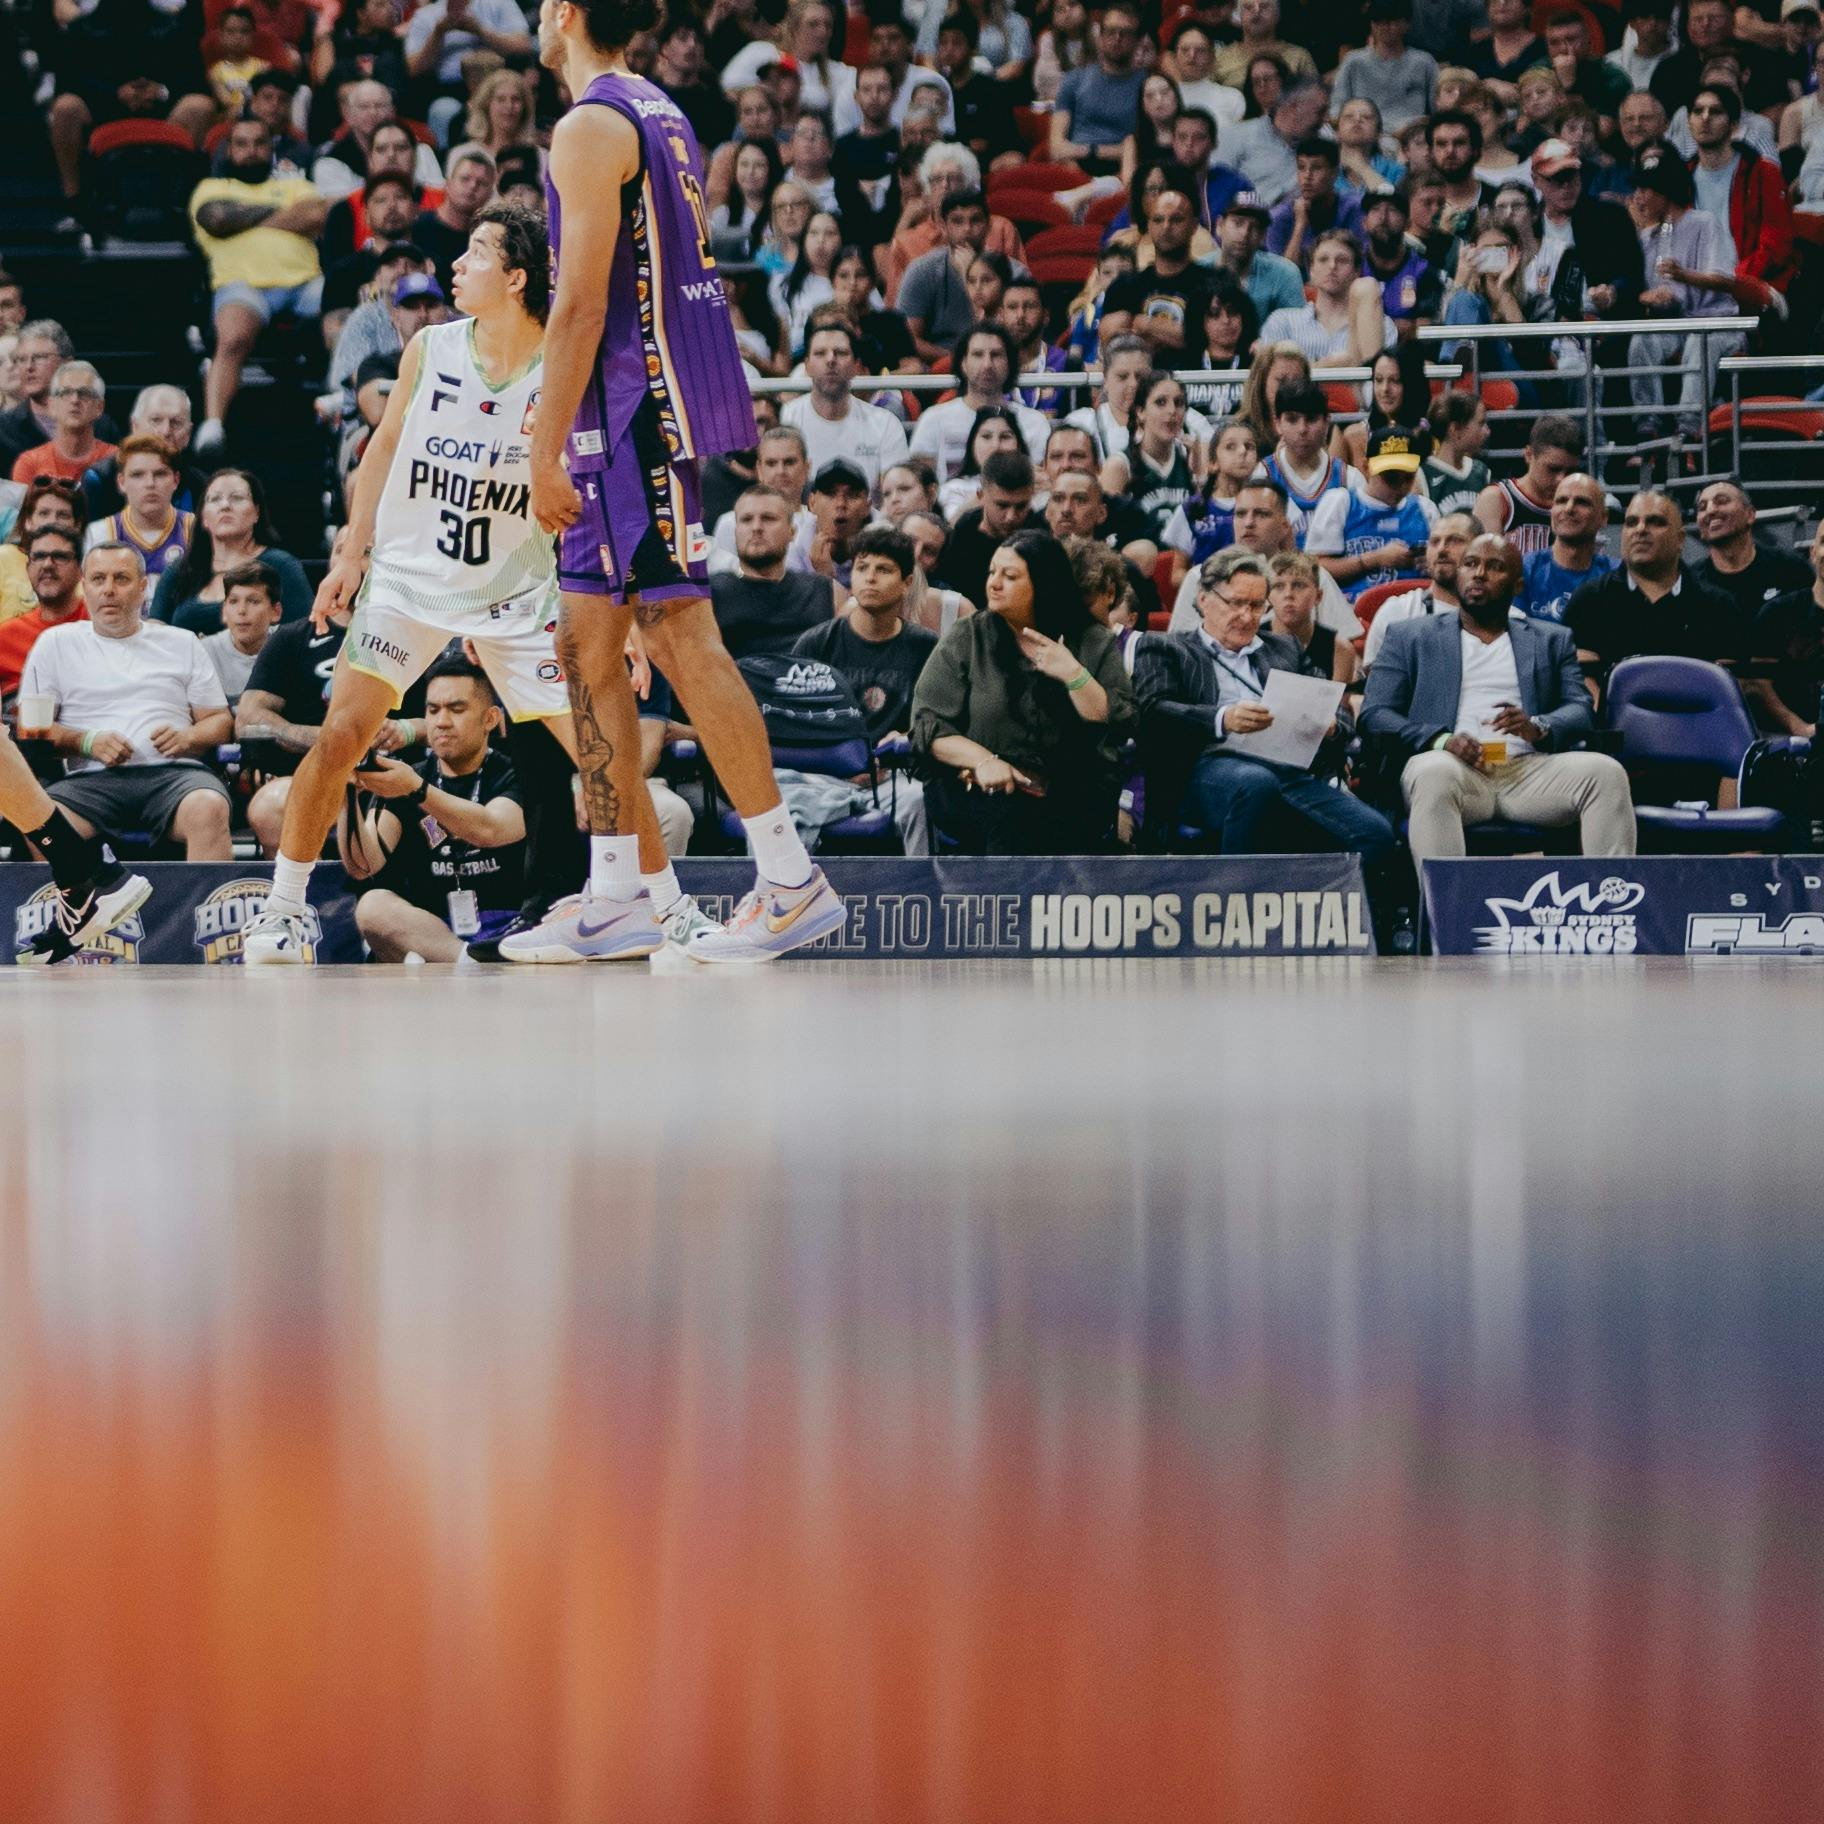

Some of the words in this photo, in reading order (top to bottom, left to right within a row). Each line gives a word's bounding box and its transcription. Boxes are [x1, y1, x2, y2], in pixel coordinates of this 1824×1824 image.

[425, 437, 496, 464] GOAT
[408, 459, 531, 521] PHOENIX
[436, 509, 493, 568] 30
[360, 631, 411, 668] TRADIE
[431, 858, 502, 877] BASETBALL
[873, 894, 932, 951] TO
[941, 895, 1019, 951] THE
[1030, 894, 1182, 953] HOOPS
[1190, 892, 1370, 953] CAPITAL
[1566, 915, 1637, 927] SYDNEY
[1510, 926, 1639, 955] KINGS
